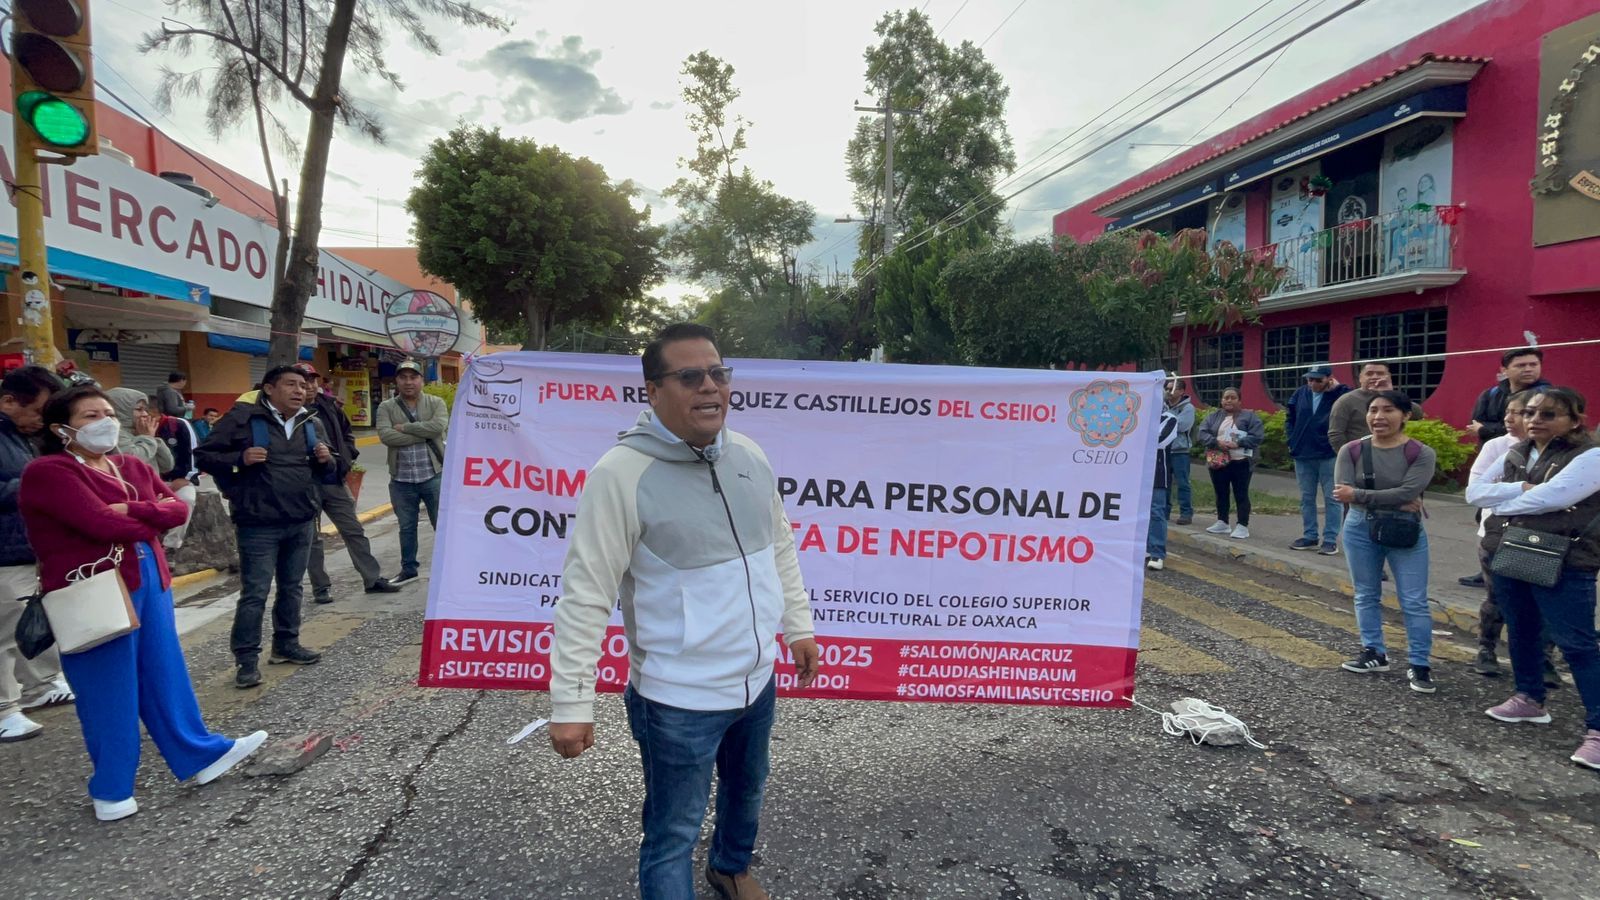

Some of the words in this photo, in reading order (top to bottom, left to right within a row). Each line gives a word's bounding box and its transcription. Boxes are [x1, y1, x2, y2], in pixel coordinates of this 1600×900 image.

[316, 266, 391, 315] HIDALG
[493, 393, 517, 405] 570
[538, 382, 617, 404] ¡FUERA
[623, 386, 648, 404] RE
[729, 390, 787, 411] QUEZ
[793, 393, 932, 416] CASTILLEJOS
[937, 399, 974, 418] DEL
[980, 401, 1057, 423] CSEIIO!
[1072, 449, 1128, 465] CSEIIO
[463, 456, 587, 498] EXIGIM
[777, 476, 875, 509] PARA
[884, 481, 1070, 519] PERSONAL
[1078, 491, 1122, 521] DE
[484, 505, 577, 539] CON
[837, 525, 880, 556] DE
[889, 528, 1095, 564] NEPOTISMO
[478, 570, 562, 588] SINDICAT
[823, 588, 898, 606] SERVICIO
[904, 593, 934, 608] DEL
[939, 594, 1008, 609] COLEGIO
[1012, 596, 1091, 612] SUPERIOR
[810, 607, 942, 627] NTERCULTURAL
[947, 614, 967, 627] DE
[972, 614, 1037, 629] OAXACA
[440, 624, 554, 655] REVISIÓ
[817, 643, 873, 668] 2025
[899, 643, 1073, 663] #SALOMÓNJARACRUZ
[438, 660, 545, 680] ¡SUTCSEIIO
[897, 664, 1077, 682] #CLAUDIASHEINBAUM
[896, 683, 1114, 703] #SOMOSFAMILIASUTCSEIIO
